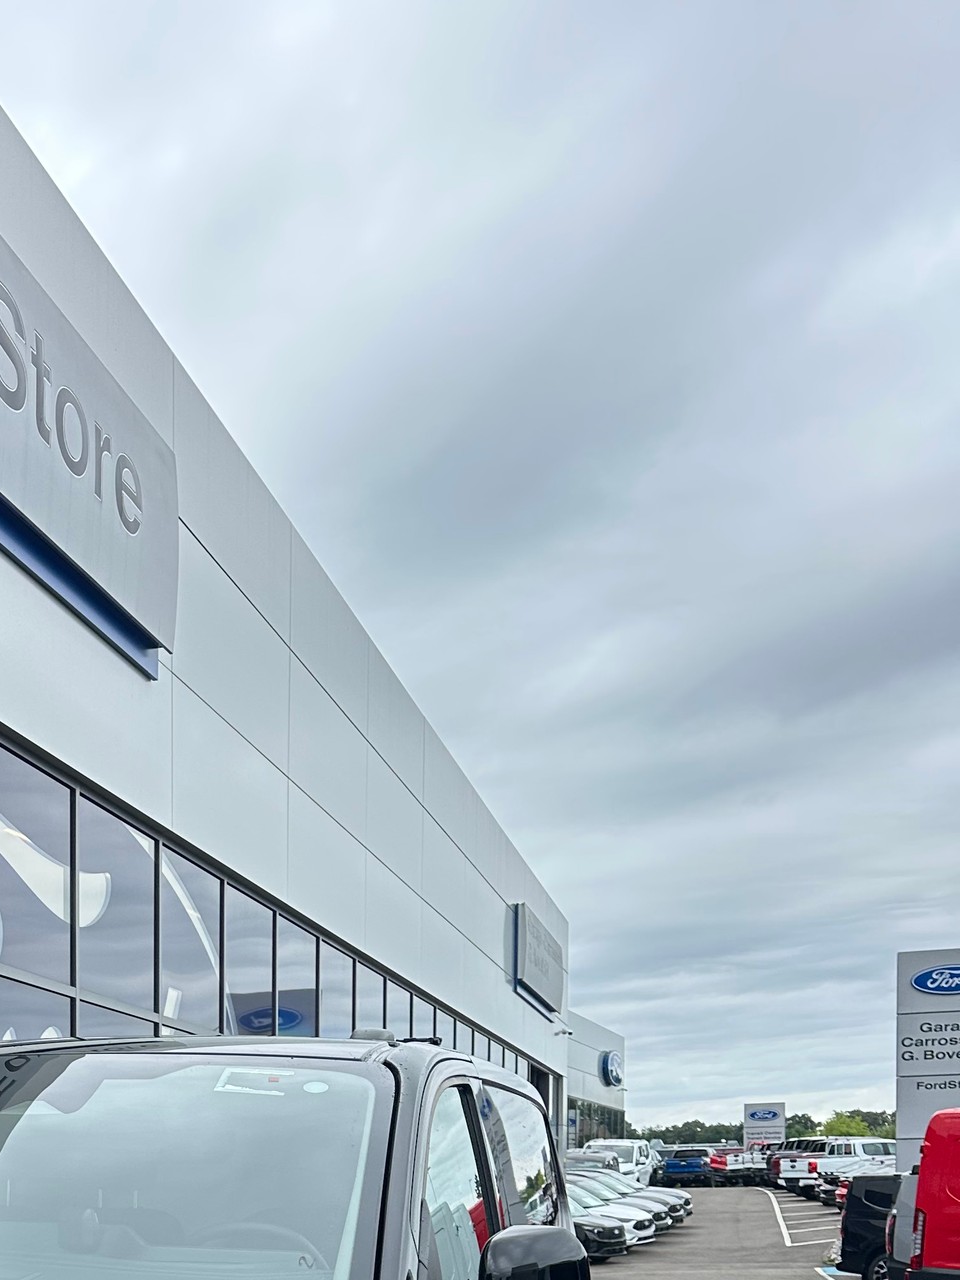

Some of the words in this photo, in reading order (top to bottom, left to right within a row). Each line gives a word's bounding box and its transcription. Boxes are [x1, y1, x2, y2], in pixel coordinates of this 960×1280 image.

[920, 1022, 960, 1033] Gara
[901, 1036, 960, 1047] Carros
[901, 1050, 919, 1061] G.
[923, 1049, 960, 1061] Bove
